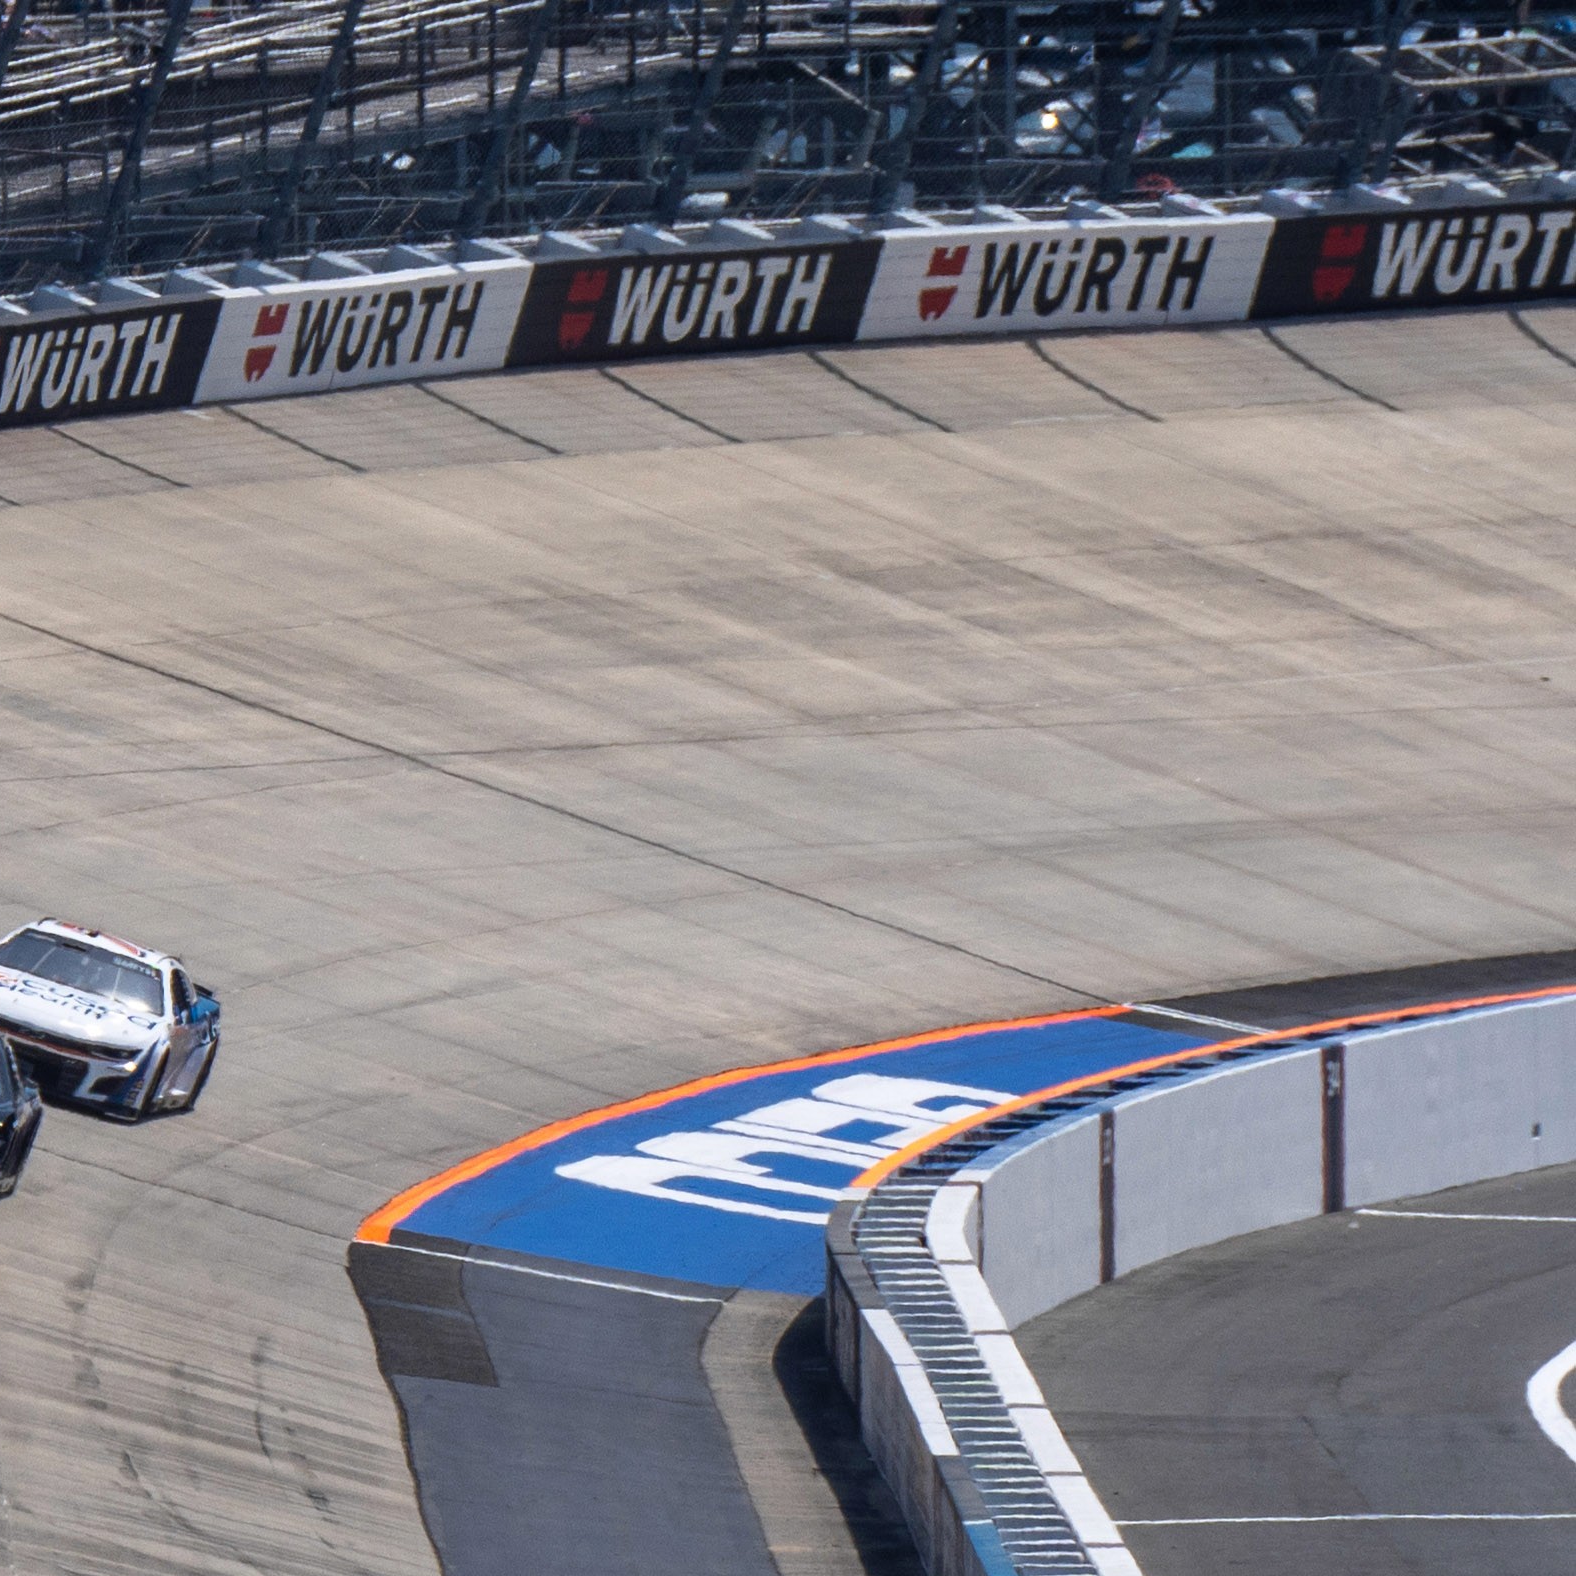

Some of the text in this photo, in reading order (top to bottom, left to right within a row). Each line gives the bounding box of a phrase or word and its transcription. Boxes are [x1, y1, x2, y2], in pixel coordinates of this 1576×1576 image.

[975, 236, 1215, 319] WÜRTH
[1371, 210, 1576, 298] WÜRT
[288, 281, 486, 379] WÜRTH
[607, 254, 833, 346] WÜRTH
